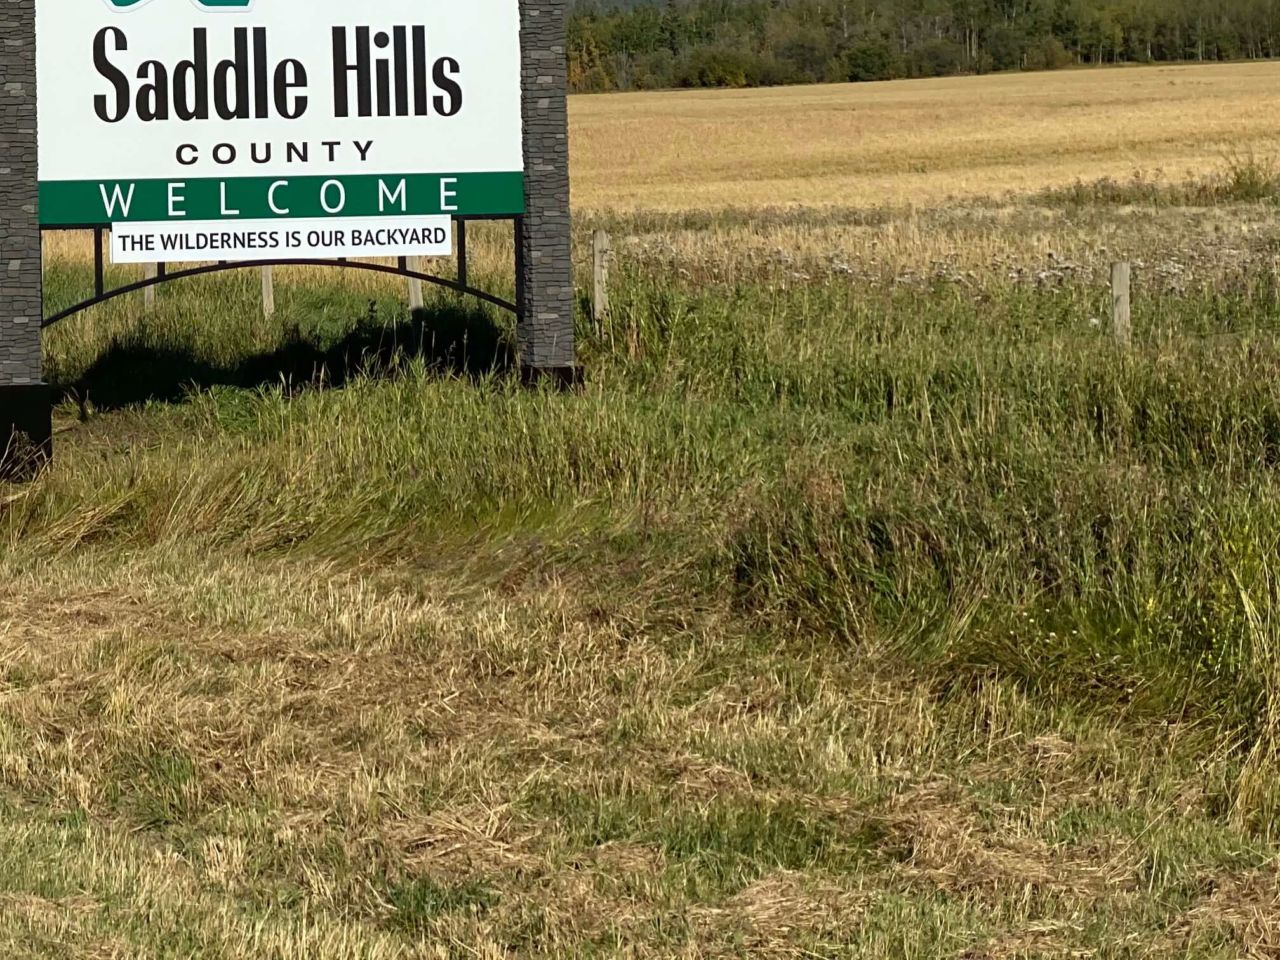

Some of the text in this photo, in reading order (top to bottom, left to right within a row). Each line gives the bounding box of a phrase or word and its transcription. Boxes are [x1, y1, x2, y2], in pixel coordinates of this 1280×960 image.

[92, 24, 463, 123] Saddle Hills
[175, 140, 375, 165] COUNTY
[99, 177, 459, 218] WELCOME
[118, 227, 447, 252] THE WILDERNESS IS OUR BACKYARD
